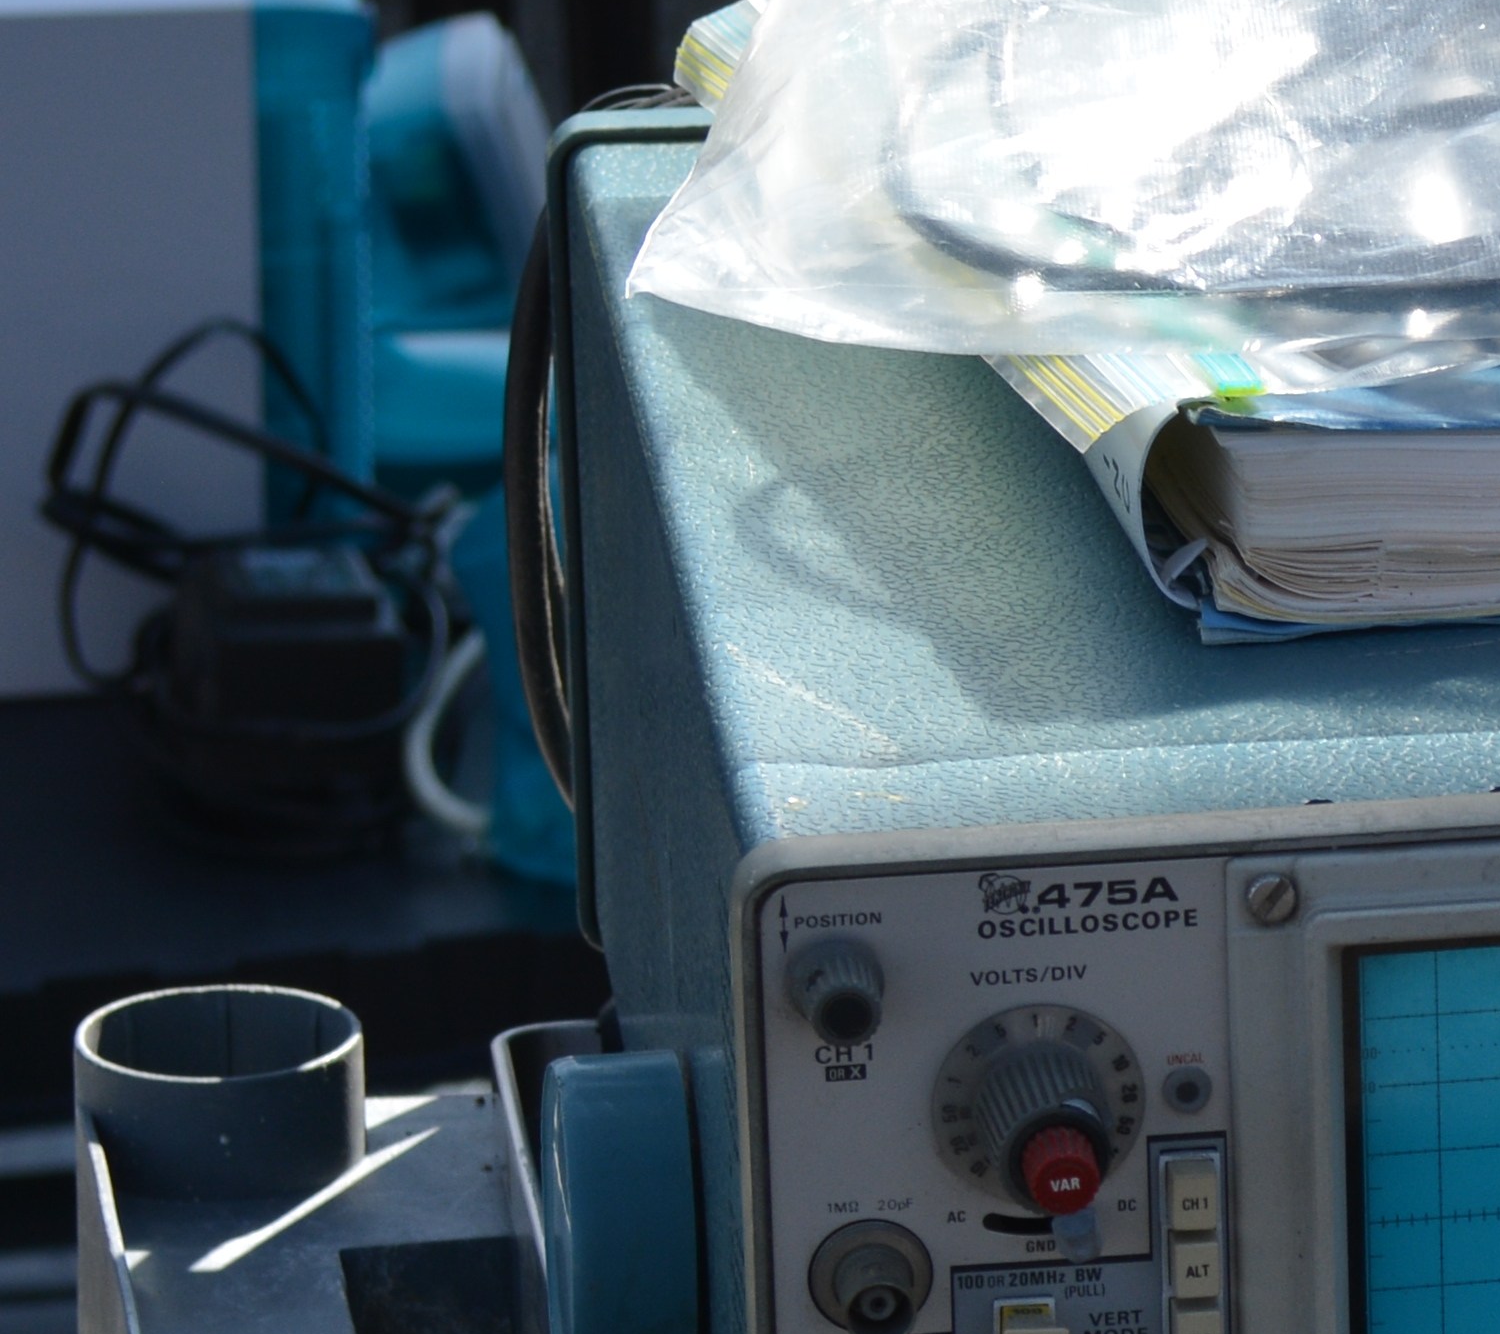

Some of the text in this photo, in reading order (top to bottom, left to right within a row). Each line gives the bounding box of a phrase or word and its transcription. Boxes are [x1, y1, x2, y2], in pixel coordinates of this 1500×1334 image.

[1037, 876, 1179, 908] 475A
[794, 912, 882, 929] POSITION
[978, 908, 1198, 939] OSCILLOSCOPE
[970, 965, 1087, 986] VOLTS/DIV
[1167, 1053, 1204, 1066] UNCAL
[1050, 1177, 1080, 1192] VAR
[1026, 1239, 1056, 1253] GND
[957, 1273, 985, 1290] 100
[1009, 1268, 1066, 1287] 20MHz
[1075, 1267, 1102, 1283] BW
[1064, 1282, 1106, 1300] (PULL)
[1089, 1309, 1143, 1326] VERT
